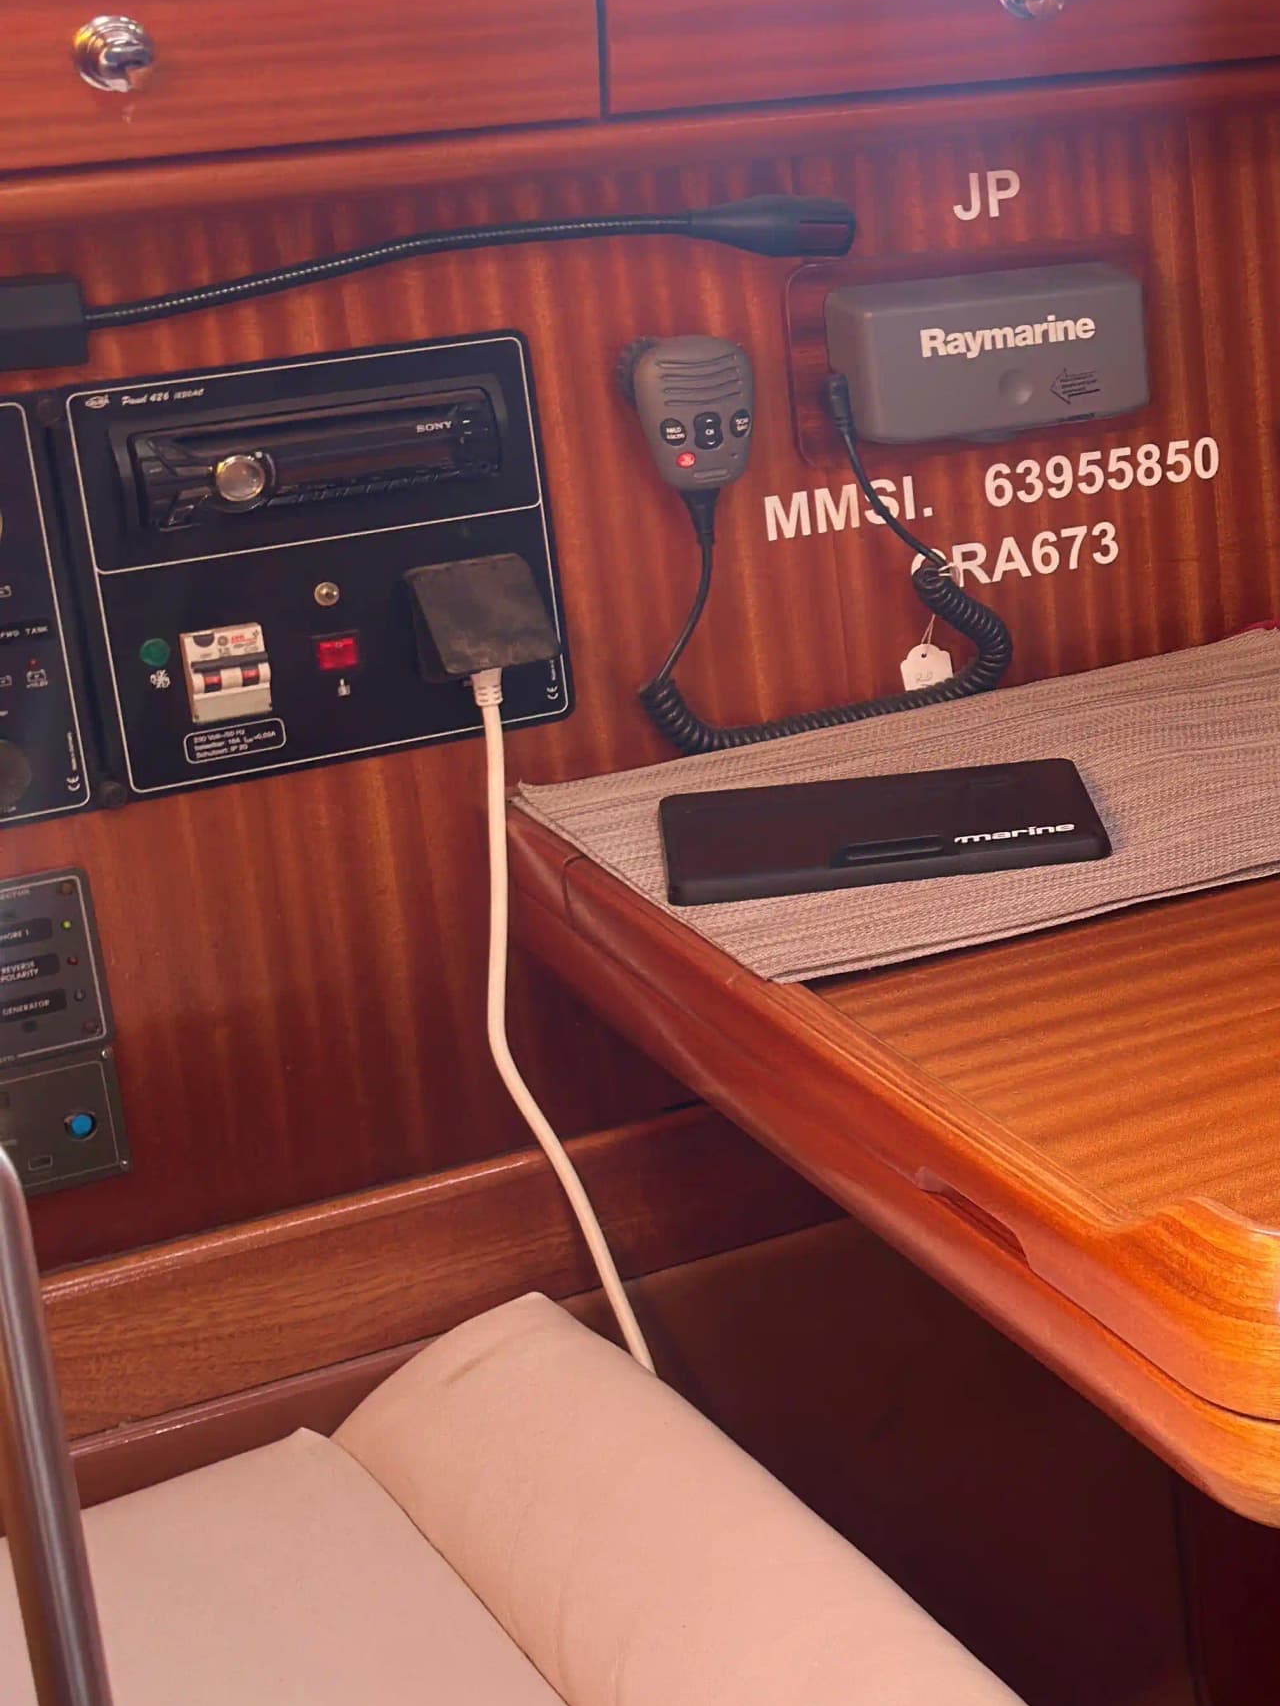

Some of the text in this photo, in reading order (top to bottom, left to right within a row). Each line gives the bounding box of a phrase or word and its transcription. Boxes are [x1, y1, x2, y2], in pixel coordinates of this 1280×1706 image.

[953, 169, 1021, 221] JP
[920, 314, 1096, 359] Raymarine
[416, 420, 453, 433] SONY
[763, 436, 1220, 541] MMSI. 63955850
[2, 999, 50, 1015] GENERATOR
